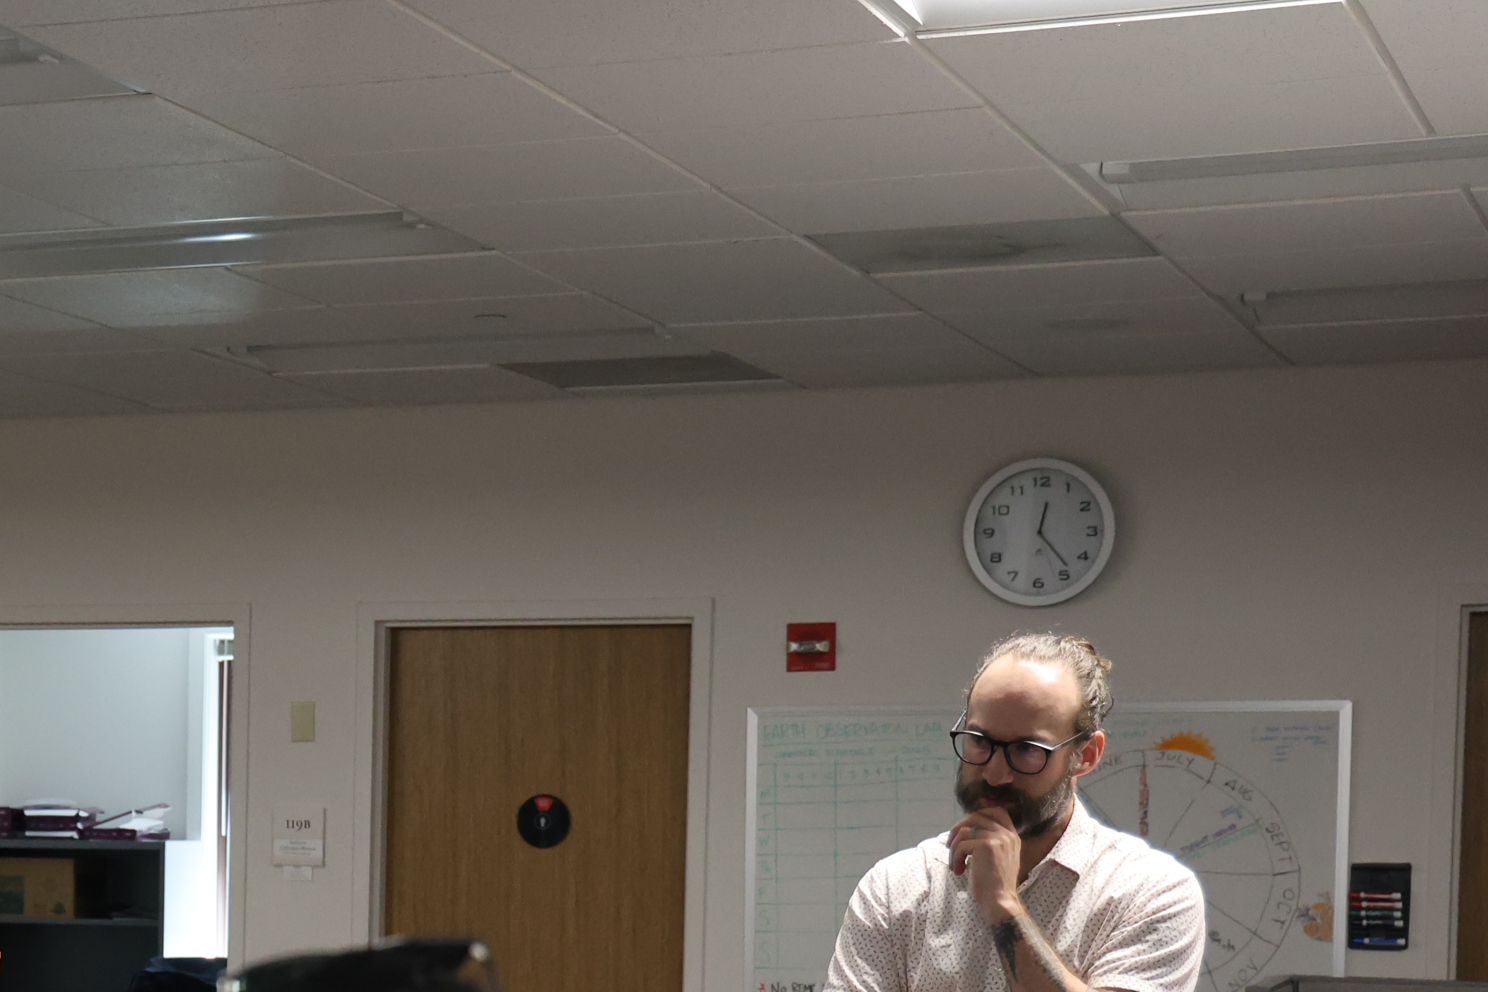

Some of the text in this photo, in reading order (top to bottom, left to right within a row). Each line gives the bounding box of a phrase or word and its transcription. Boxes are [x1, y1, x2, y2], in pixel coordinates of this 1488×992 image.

[1032, 476, 1052, 488] 12
[1065, 482, 1071, 493] 1
[1010, 485, 1024, 496] 11
[991, 505, 1010, 516] 10
[1079, 501, 1091, 512] 2
[983, 527, 995, 538] 9
[1086, 526, 1098, 537] 3
[990, 552, 1002, 564] 8
[1076, 550, 1089, 561] 4
[1007, 571, 1019, 582] 7
[1058, 570, 1070, 581] 5
[1032, 578, 1045, 589] 6
[1155, 751, 1195, 768] JULY
[1224, 779, 1253, 801] AUG
[286, 820, 310, 831] 119B
[1265, 822, 1293, 864] SEPT
[1272, 888, 1295, 930] OCT
[1227, 957, 1258, 989] NOV
